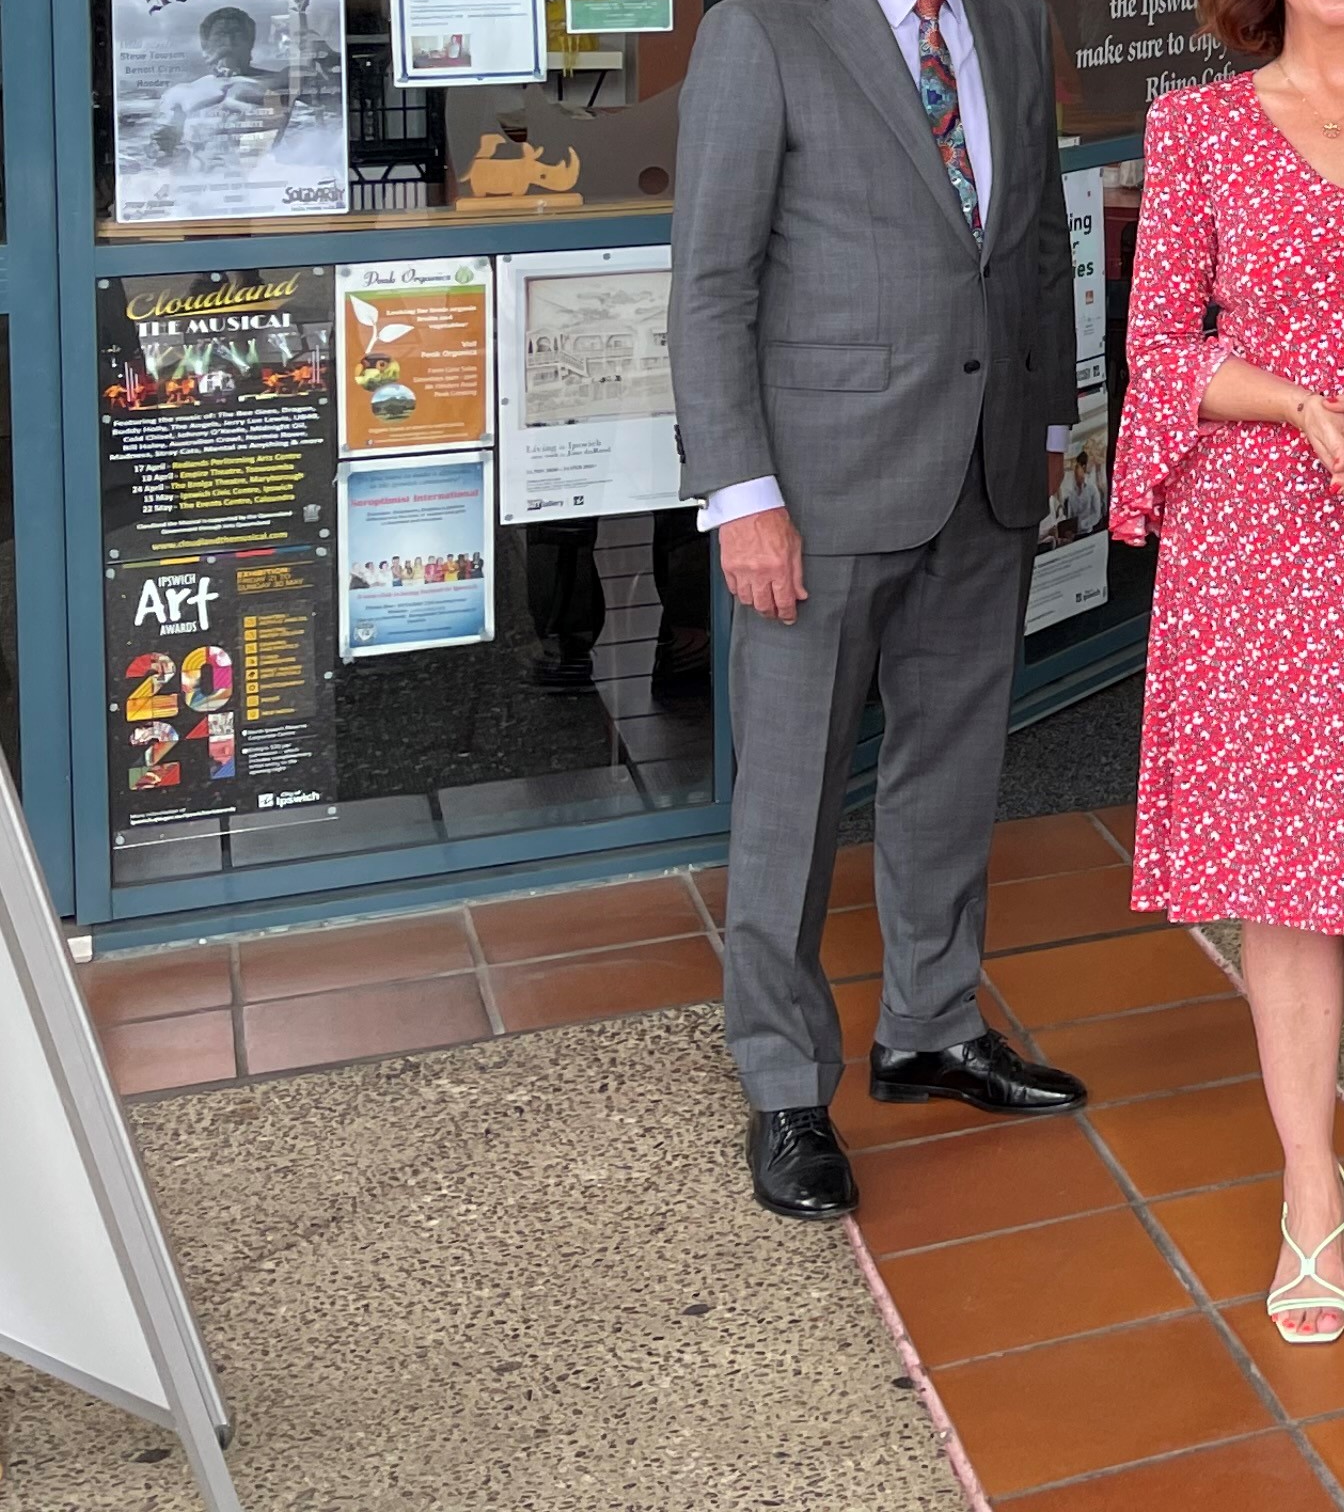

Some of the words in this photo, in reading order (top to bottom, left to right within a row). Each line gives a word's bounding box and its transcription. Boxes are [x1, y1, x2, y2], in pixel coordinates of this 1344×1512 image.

[1076, 35, 1123, 69] make
[1127, 37, 1164, 61] sure
[1167, 32, 1184, 56] to
[125, 273, 301, 320] Cloudland
[138, 320, 181, 337] THE
[186, 313, 293, 334] MUSICAL
[158, 573, 196, 587] IPSWICH
[134, 577, 219, 630] Art
[160, 622, 197, 636] AWARDS
[276, 792, 320, 807] Ipswich
